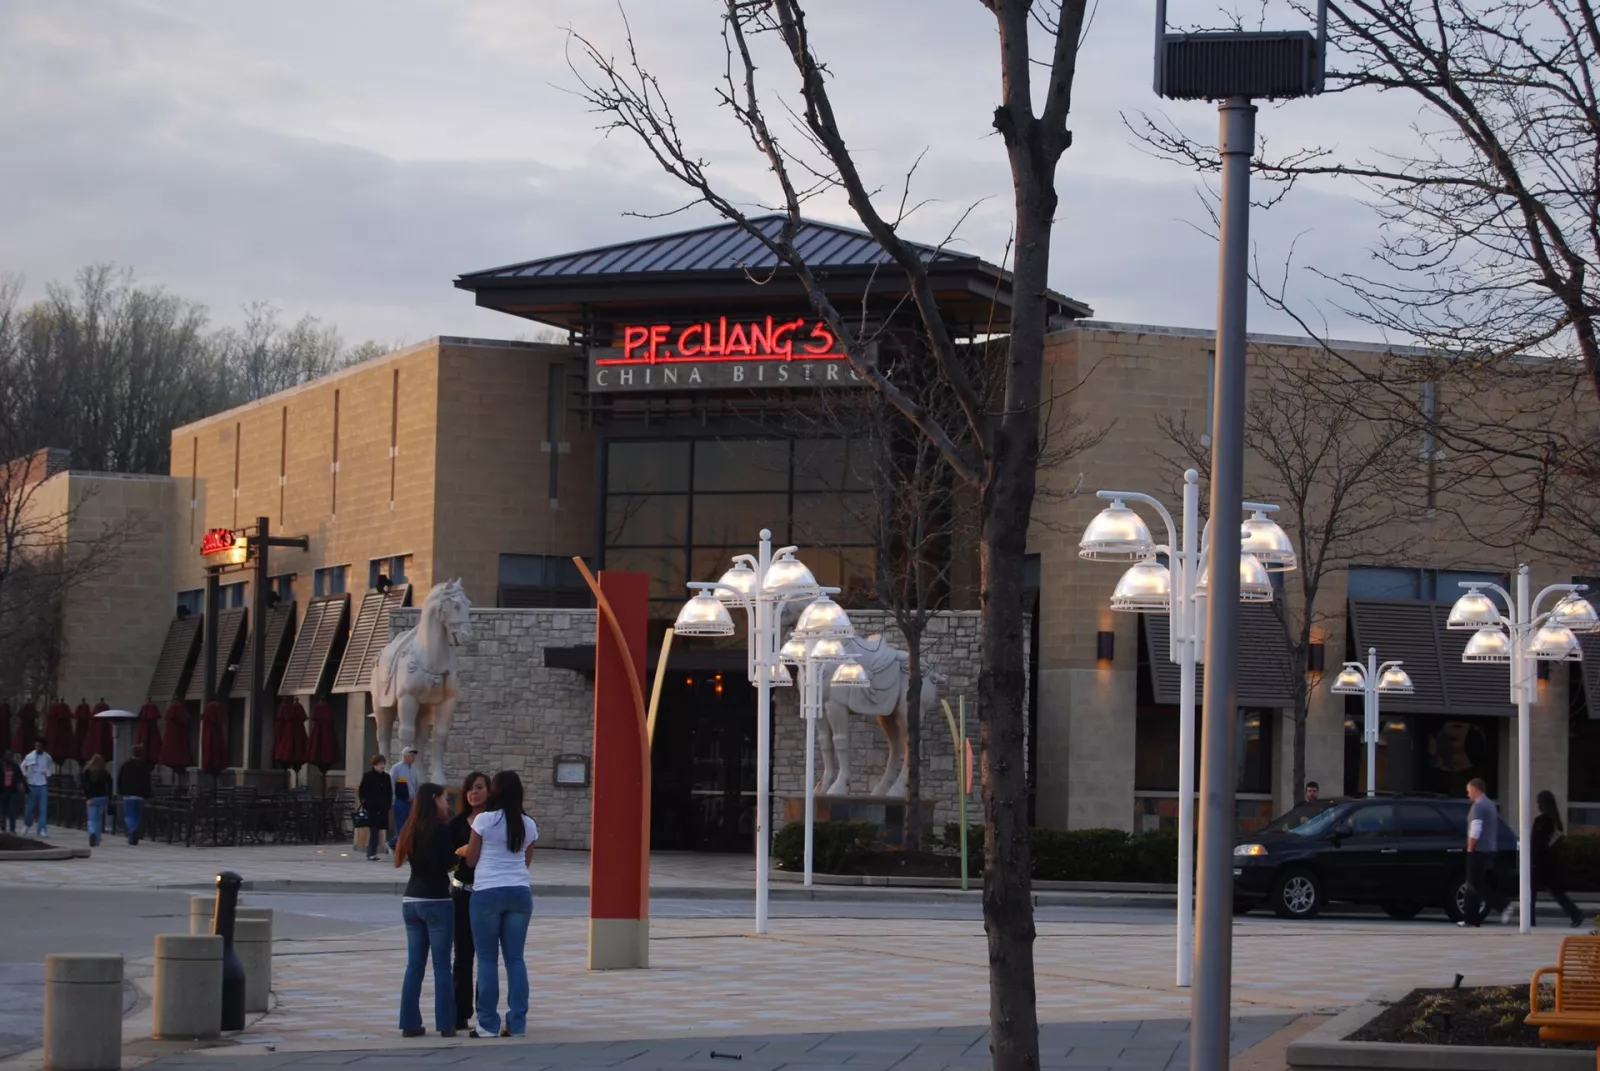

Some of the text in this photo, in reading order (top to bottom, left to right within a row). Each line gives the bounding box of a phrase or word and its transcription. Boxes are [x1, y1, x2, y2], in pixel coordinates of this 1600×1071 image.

[624, 315, 835, 364] P.F. CHANG'S
[597, 367, 702, 386] CHINA
